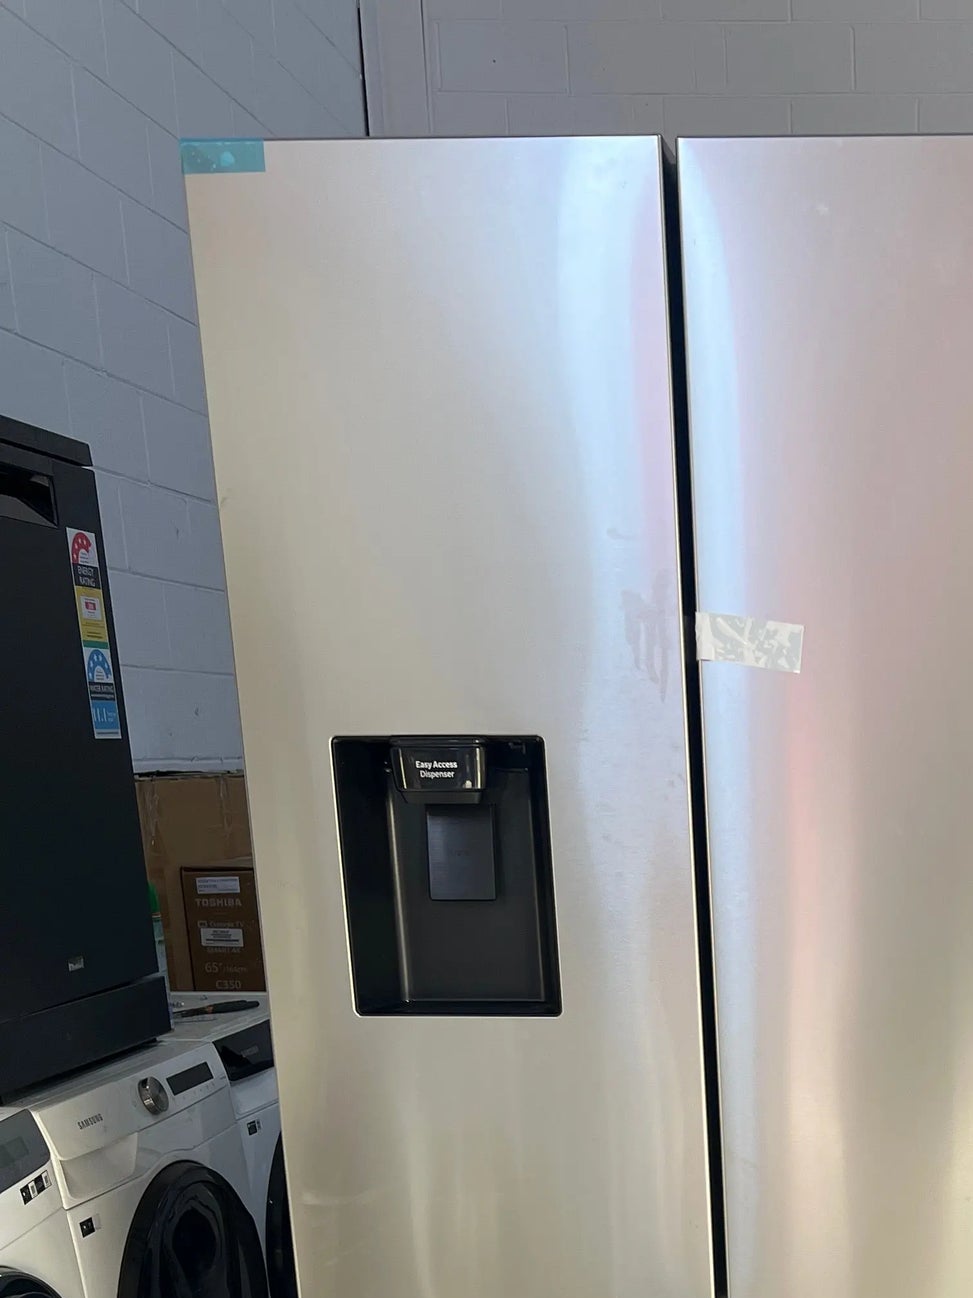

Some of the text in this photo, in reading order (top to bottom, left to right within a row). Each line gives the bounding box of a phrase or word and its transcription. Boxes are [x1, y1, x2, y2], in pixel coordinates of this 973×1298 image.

[415, 761, 458, 769] Easy Access
[420, 770, 455, 779] Dispenser
[195, 898, 242, 907] TOSHIBA
[77, 1113, 104, 1129] SAMSUNG
